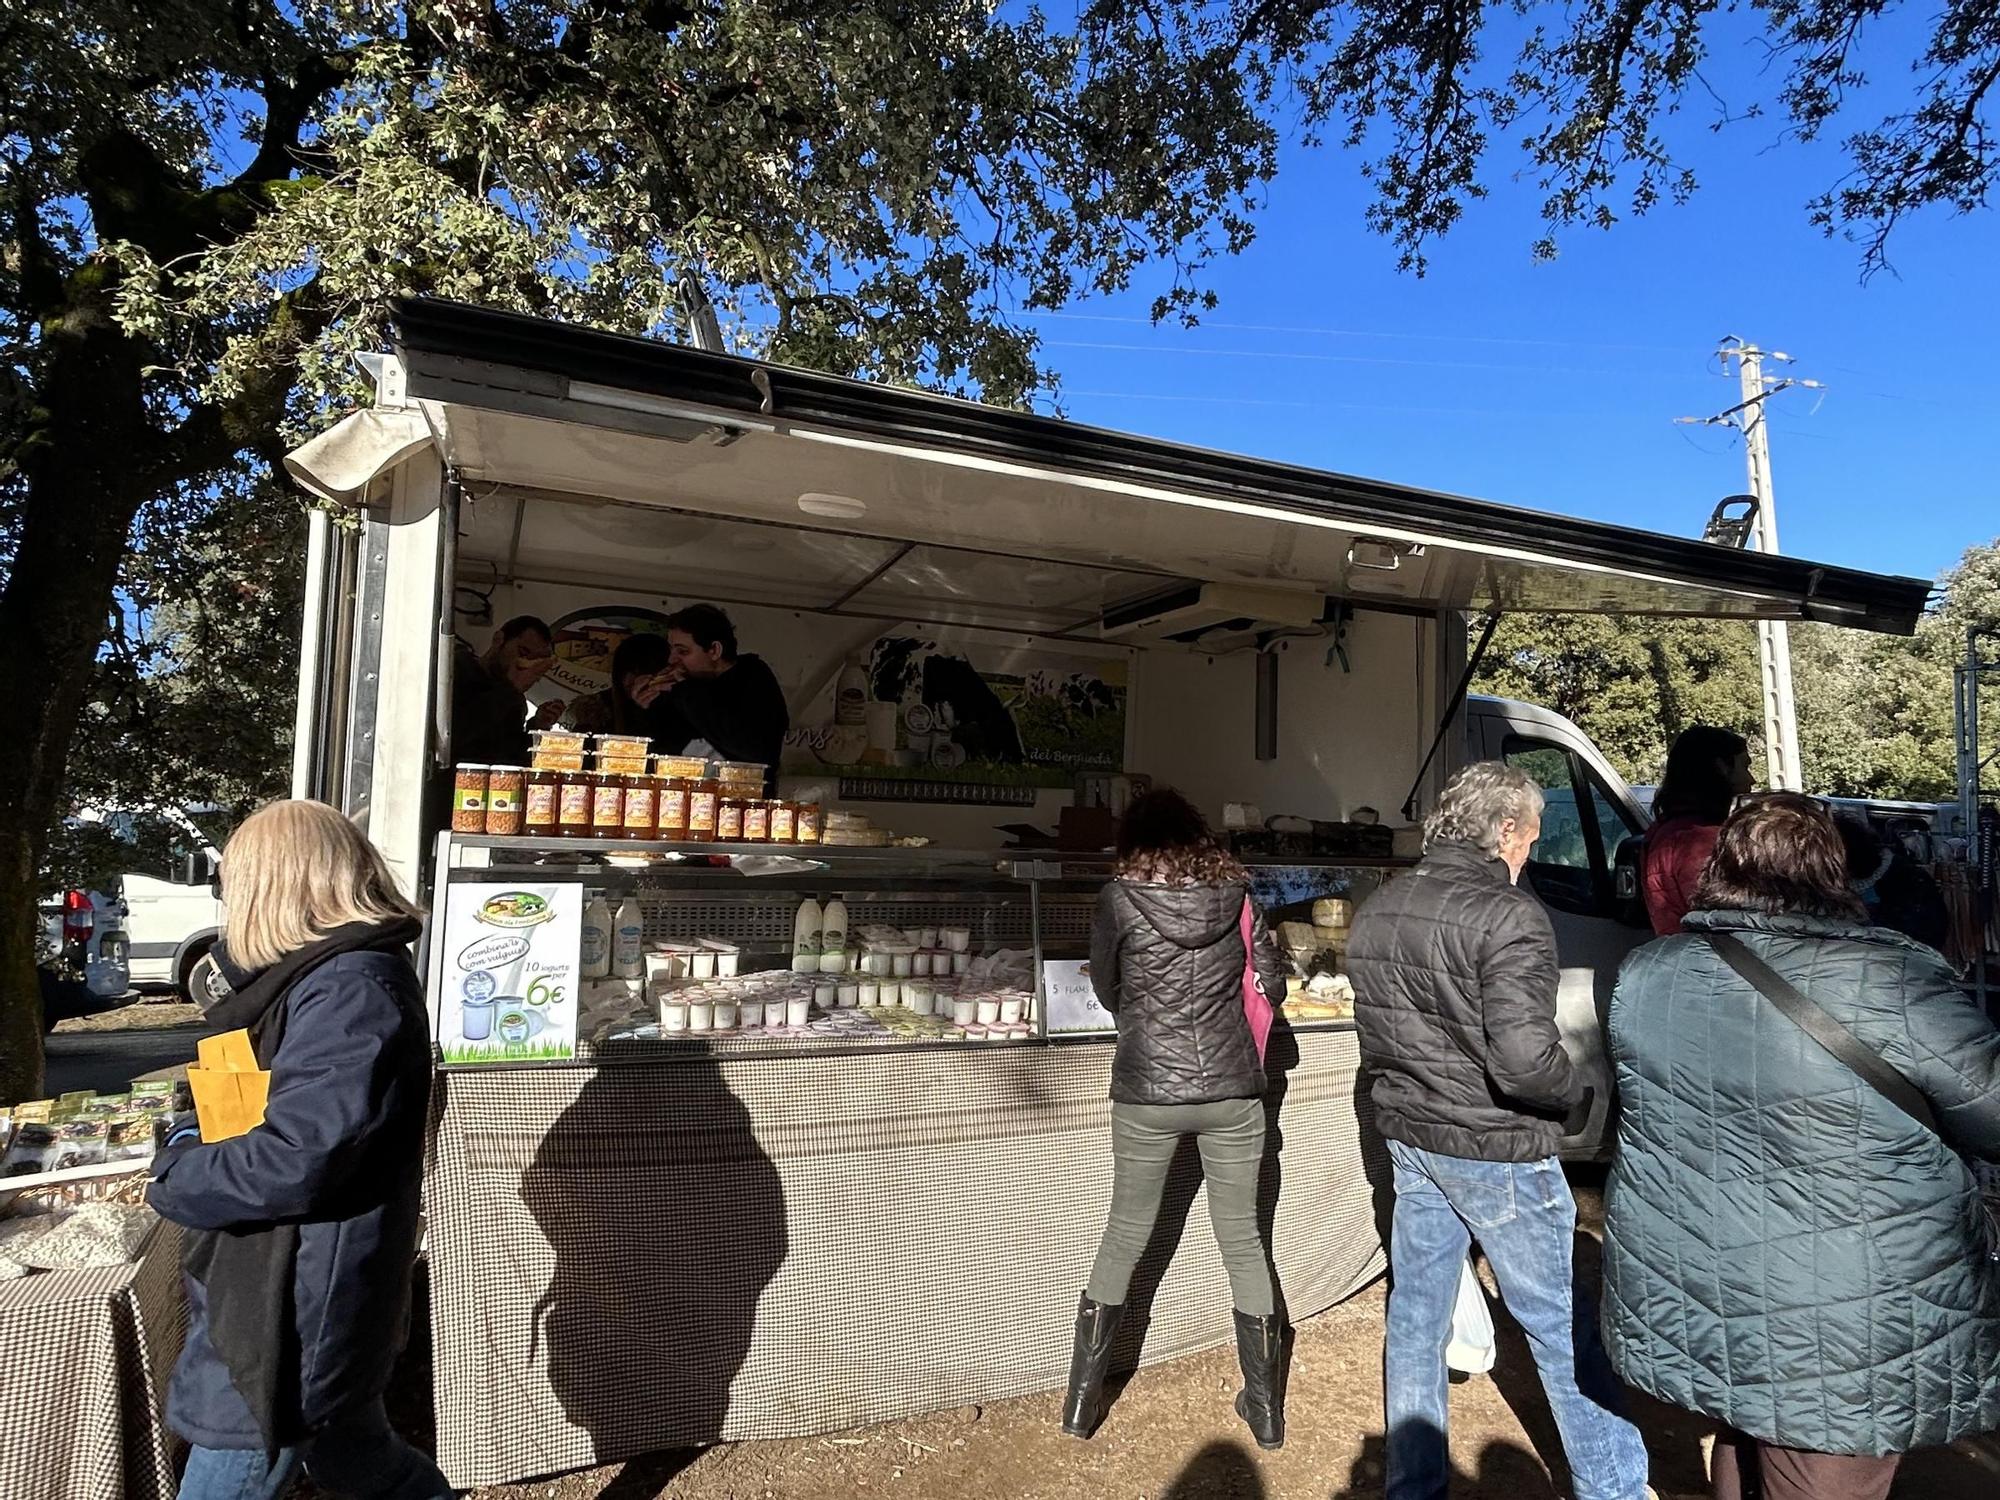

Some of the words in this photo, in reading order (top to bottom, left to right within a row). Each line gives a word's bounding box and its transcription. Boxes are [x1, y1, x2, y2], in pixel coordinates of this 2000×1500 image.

[465, 958, 486, 969] com
[526, 961, 539, 972] 10
[541, 964, 570, 973] iogurts
[526, 974, 566, 1006] 6€
[1053, 984, 1058, 994] 5
[1087, 1000, 1099, 1011] 6€
